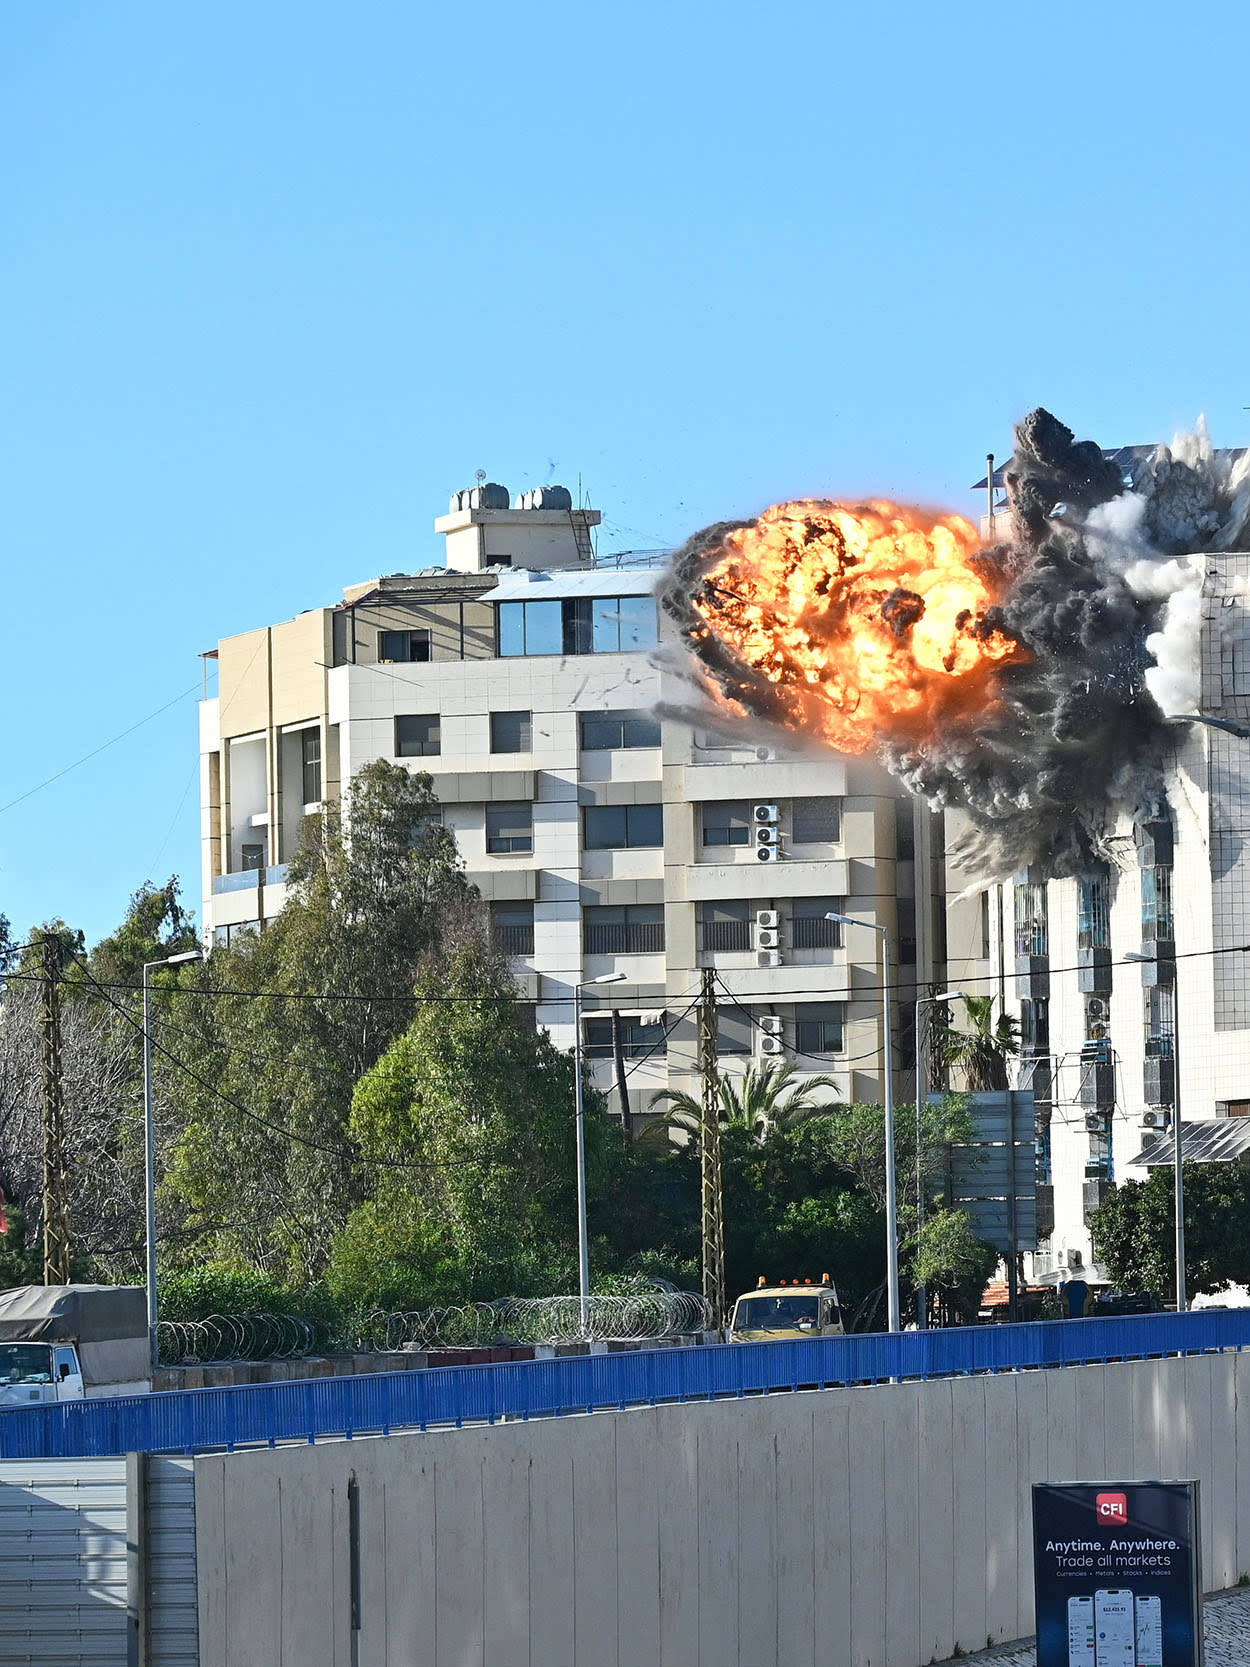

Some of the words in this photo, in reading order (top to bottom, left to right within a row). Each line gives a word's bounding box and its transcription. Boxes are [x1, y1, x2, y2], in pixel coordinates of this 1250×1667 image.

[1100, 1503, 1123, 1516] CFI
[1045, 1539, 1105, 1554] Anytime.
[1109, 1538, 1180, 1554] Anywhere.
[1055, 1555, 1094, 1567] Trade
[1097, 1554, 1112, 1567] all
[1115, 1554, 1171, 1566] markets
